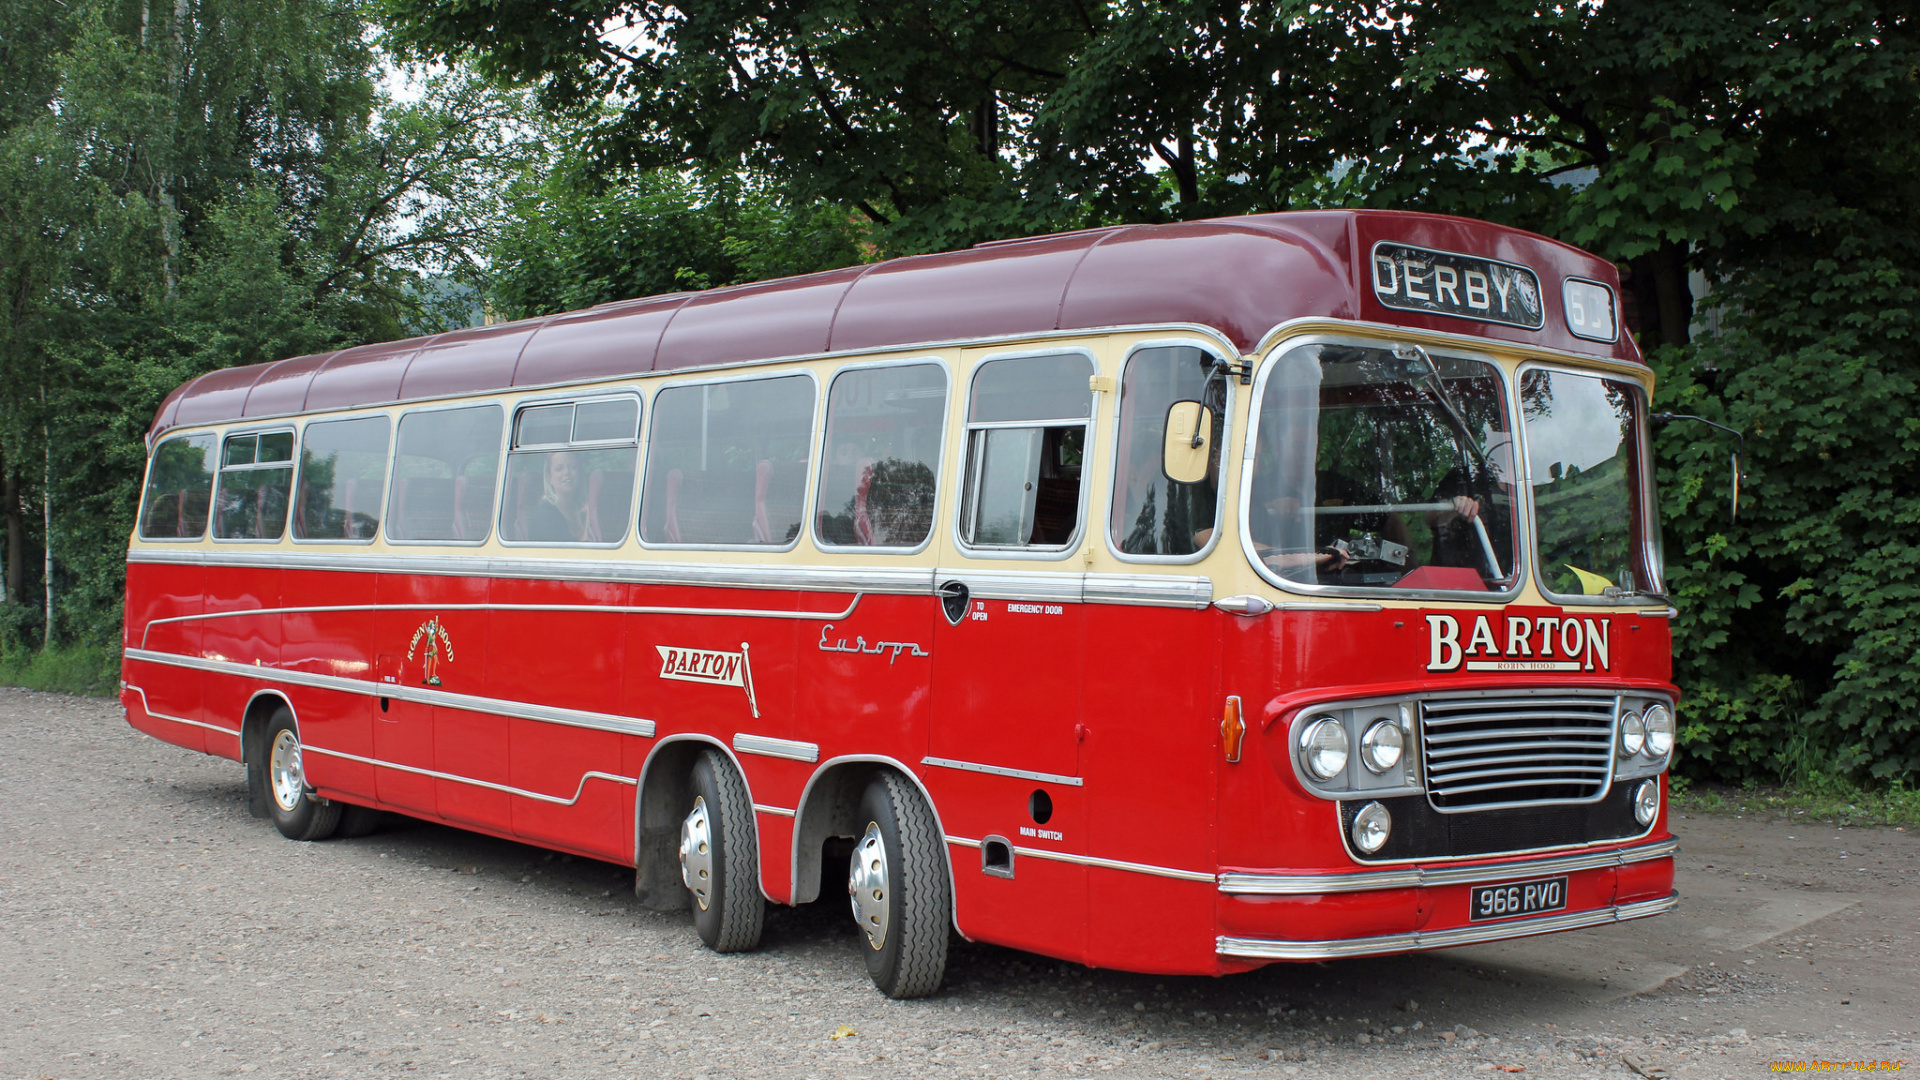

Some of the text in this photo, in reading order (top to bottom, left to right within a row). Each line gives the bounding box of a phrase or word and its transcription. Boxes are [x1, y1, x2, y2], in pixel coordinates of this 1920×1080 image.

[1375, 254, 1512, 313] DERBY
[972, 612, 988, 621] OPEN
[977, 602, 985, 610] TO
[1007, 604, 1063, 615] EMERGENCY DOOR
[407, 623, 455, 662] ROBIN HOOD
[818, 624, 930, 665] Europa
[1425, 614, 1611, 672] BARTON
[663, 650, 741, 682] BARTON
[1497, 662, 1556, 670] ROBIN HOOD
[1020, 826, 1062, 841] MAIN SWITCH
[1480, 881, 1560, 916] 966 RVO
